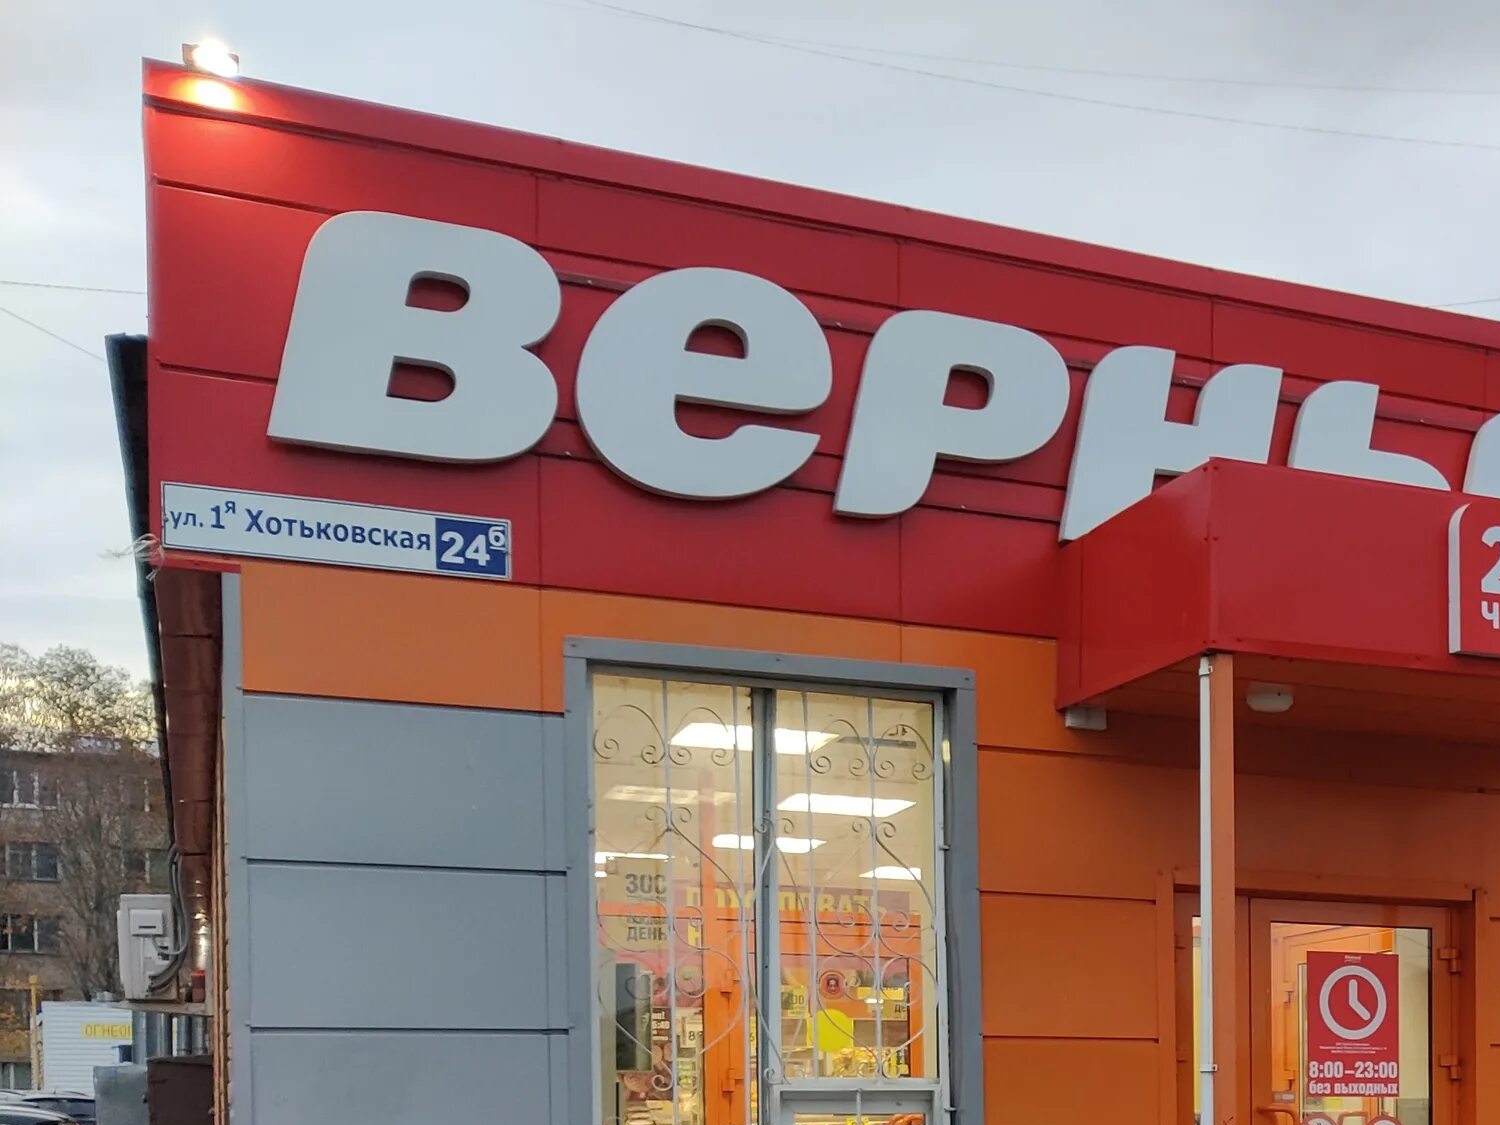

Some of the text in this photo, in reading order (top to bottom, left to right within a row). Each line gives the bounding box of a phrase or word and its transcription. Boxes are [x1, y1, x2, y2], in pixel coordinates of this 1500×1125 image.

[169, 509, 204, 529] ул.
[245, 508, 431, 551] Хотьковская
[1309, 1080, 1398, 1096] без выходных
